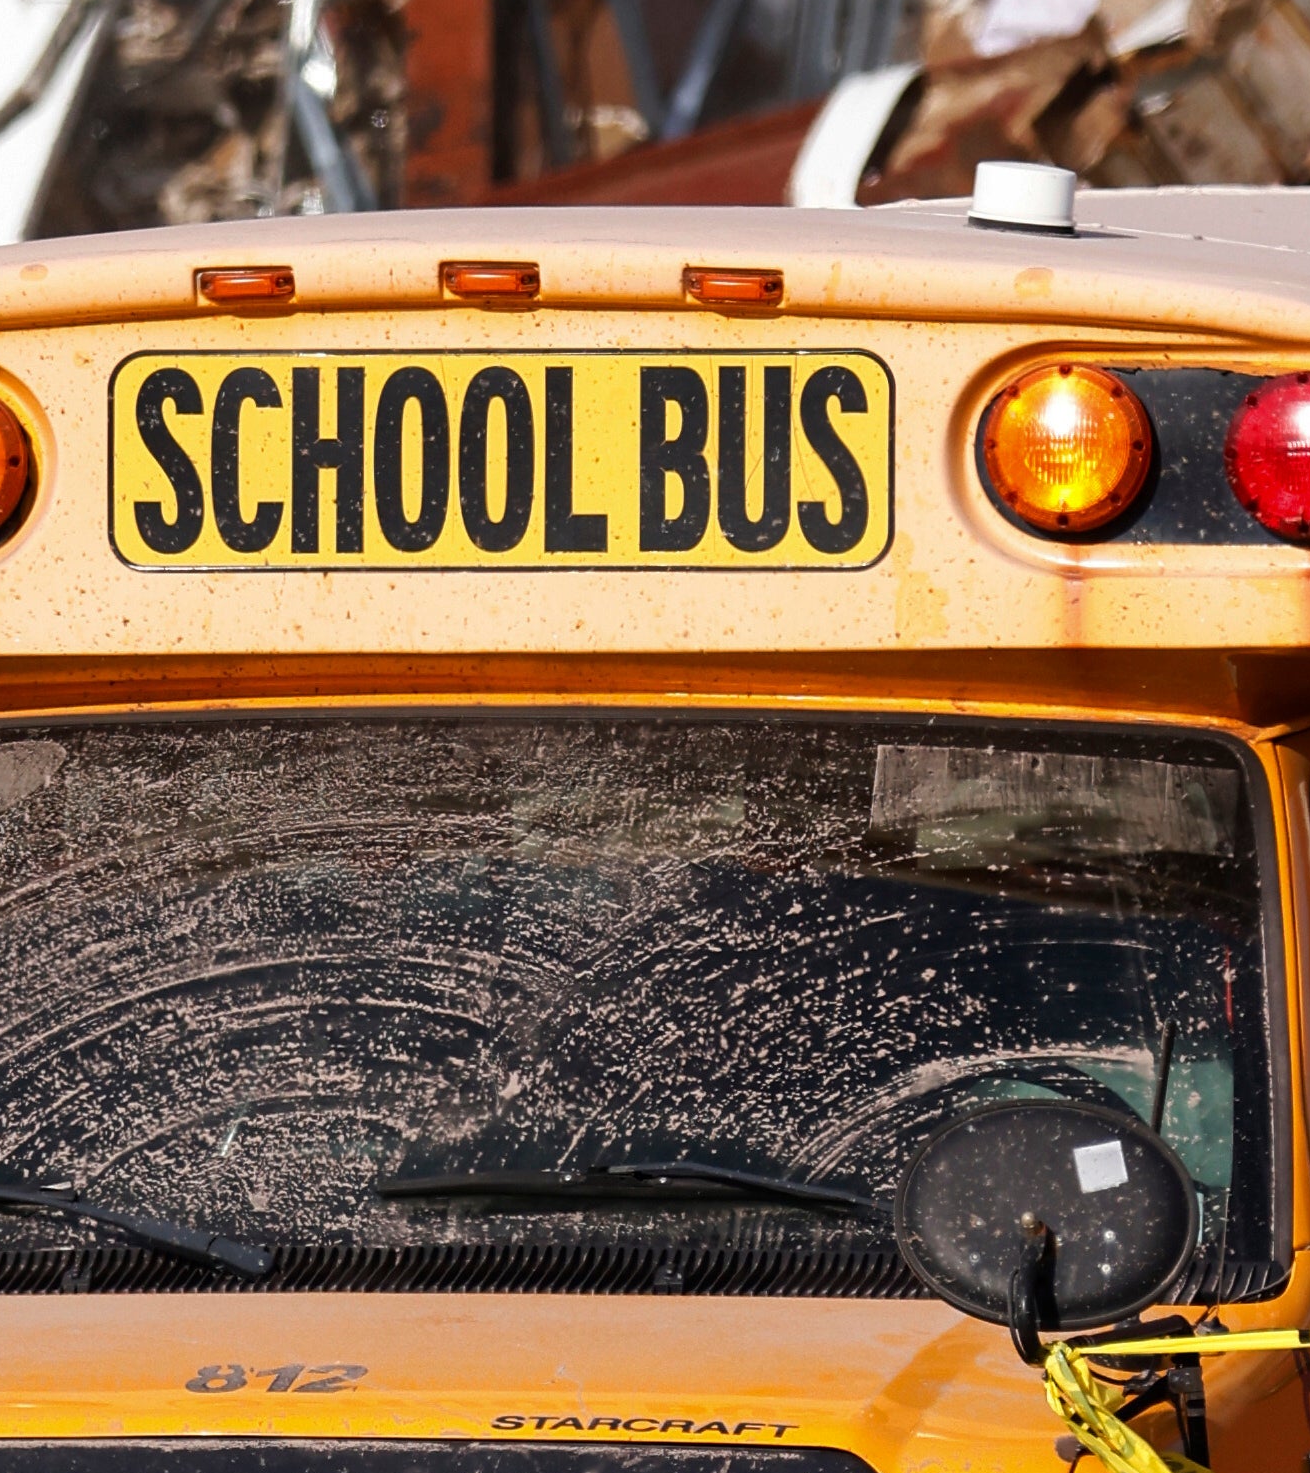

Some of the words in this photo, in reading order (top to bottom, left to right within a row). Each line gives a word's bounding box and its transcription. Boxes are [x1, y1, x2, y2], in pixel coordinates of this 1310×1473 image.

[131, 365, 610, 557] SCHOOL
[639, 362, 870, 556] BUS
[184, 1363, 368, 1395] 812
[490, 1414, 800, 1441] STARCRAFT
